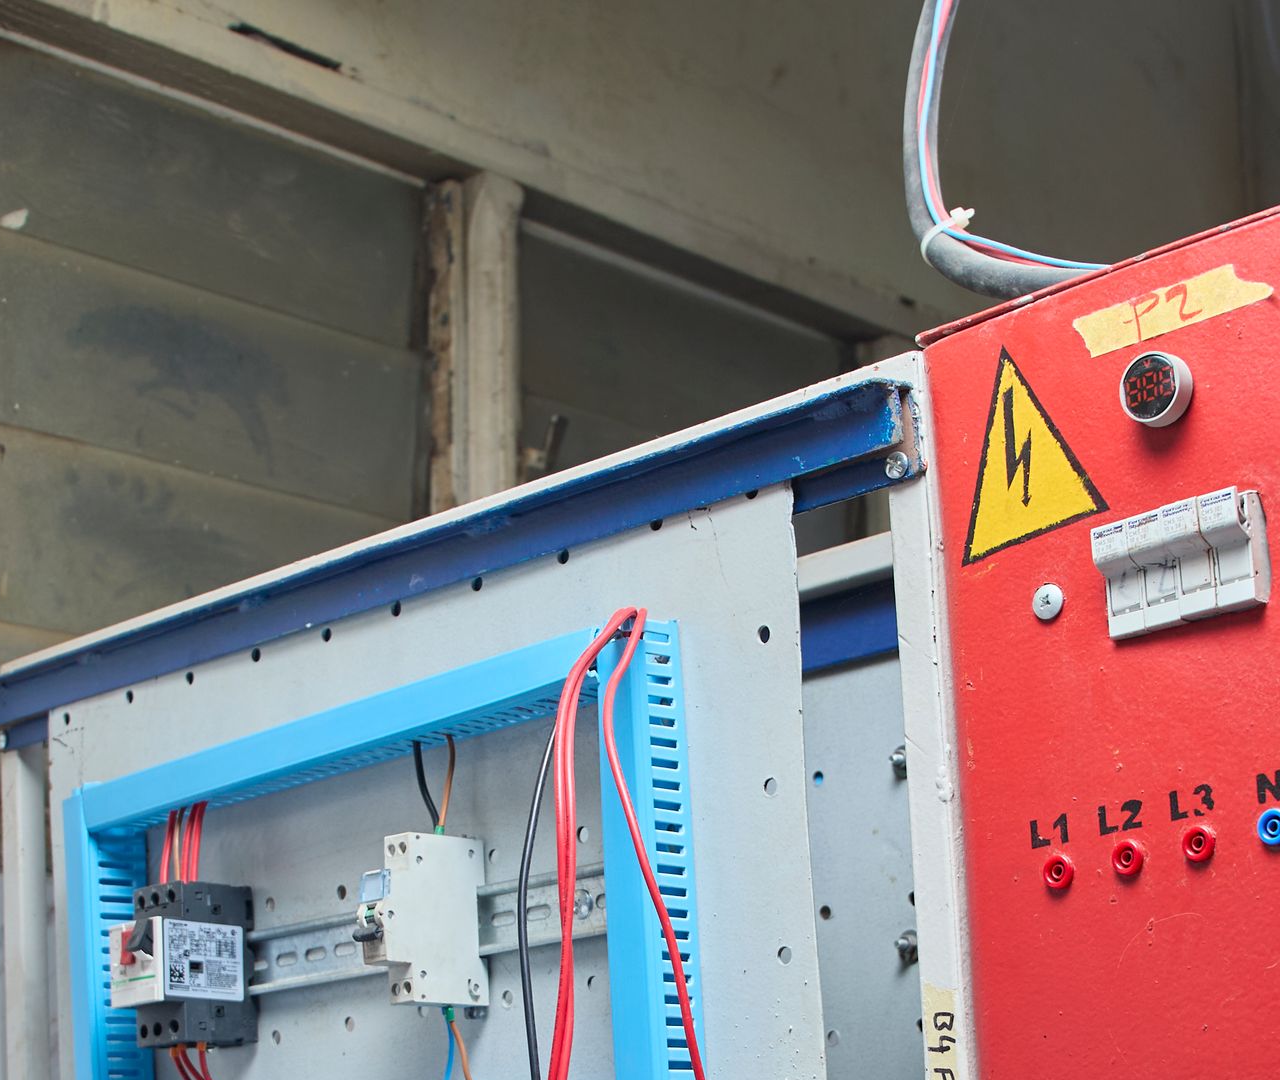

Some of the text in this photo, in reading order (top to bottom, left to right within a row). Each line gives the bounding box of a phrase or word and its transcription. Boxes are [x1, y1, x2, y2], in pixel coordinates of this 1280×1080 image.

[1124, 284, 1202, 341] P2
[1029, 813, 1070, 849] L1
[1098, 799, 1143, 836] L2
[1169, 783, 1215, 821] L3
